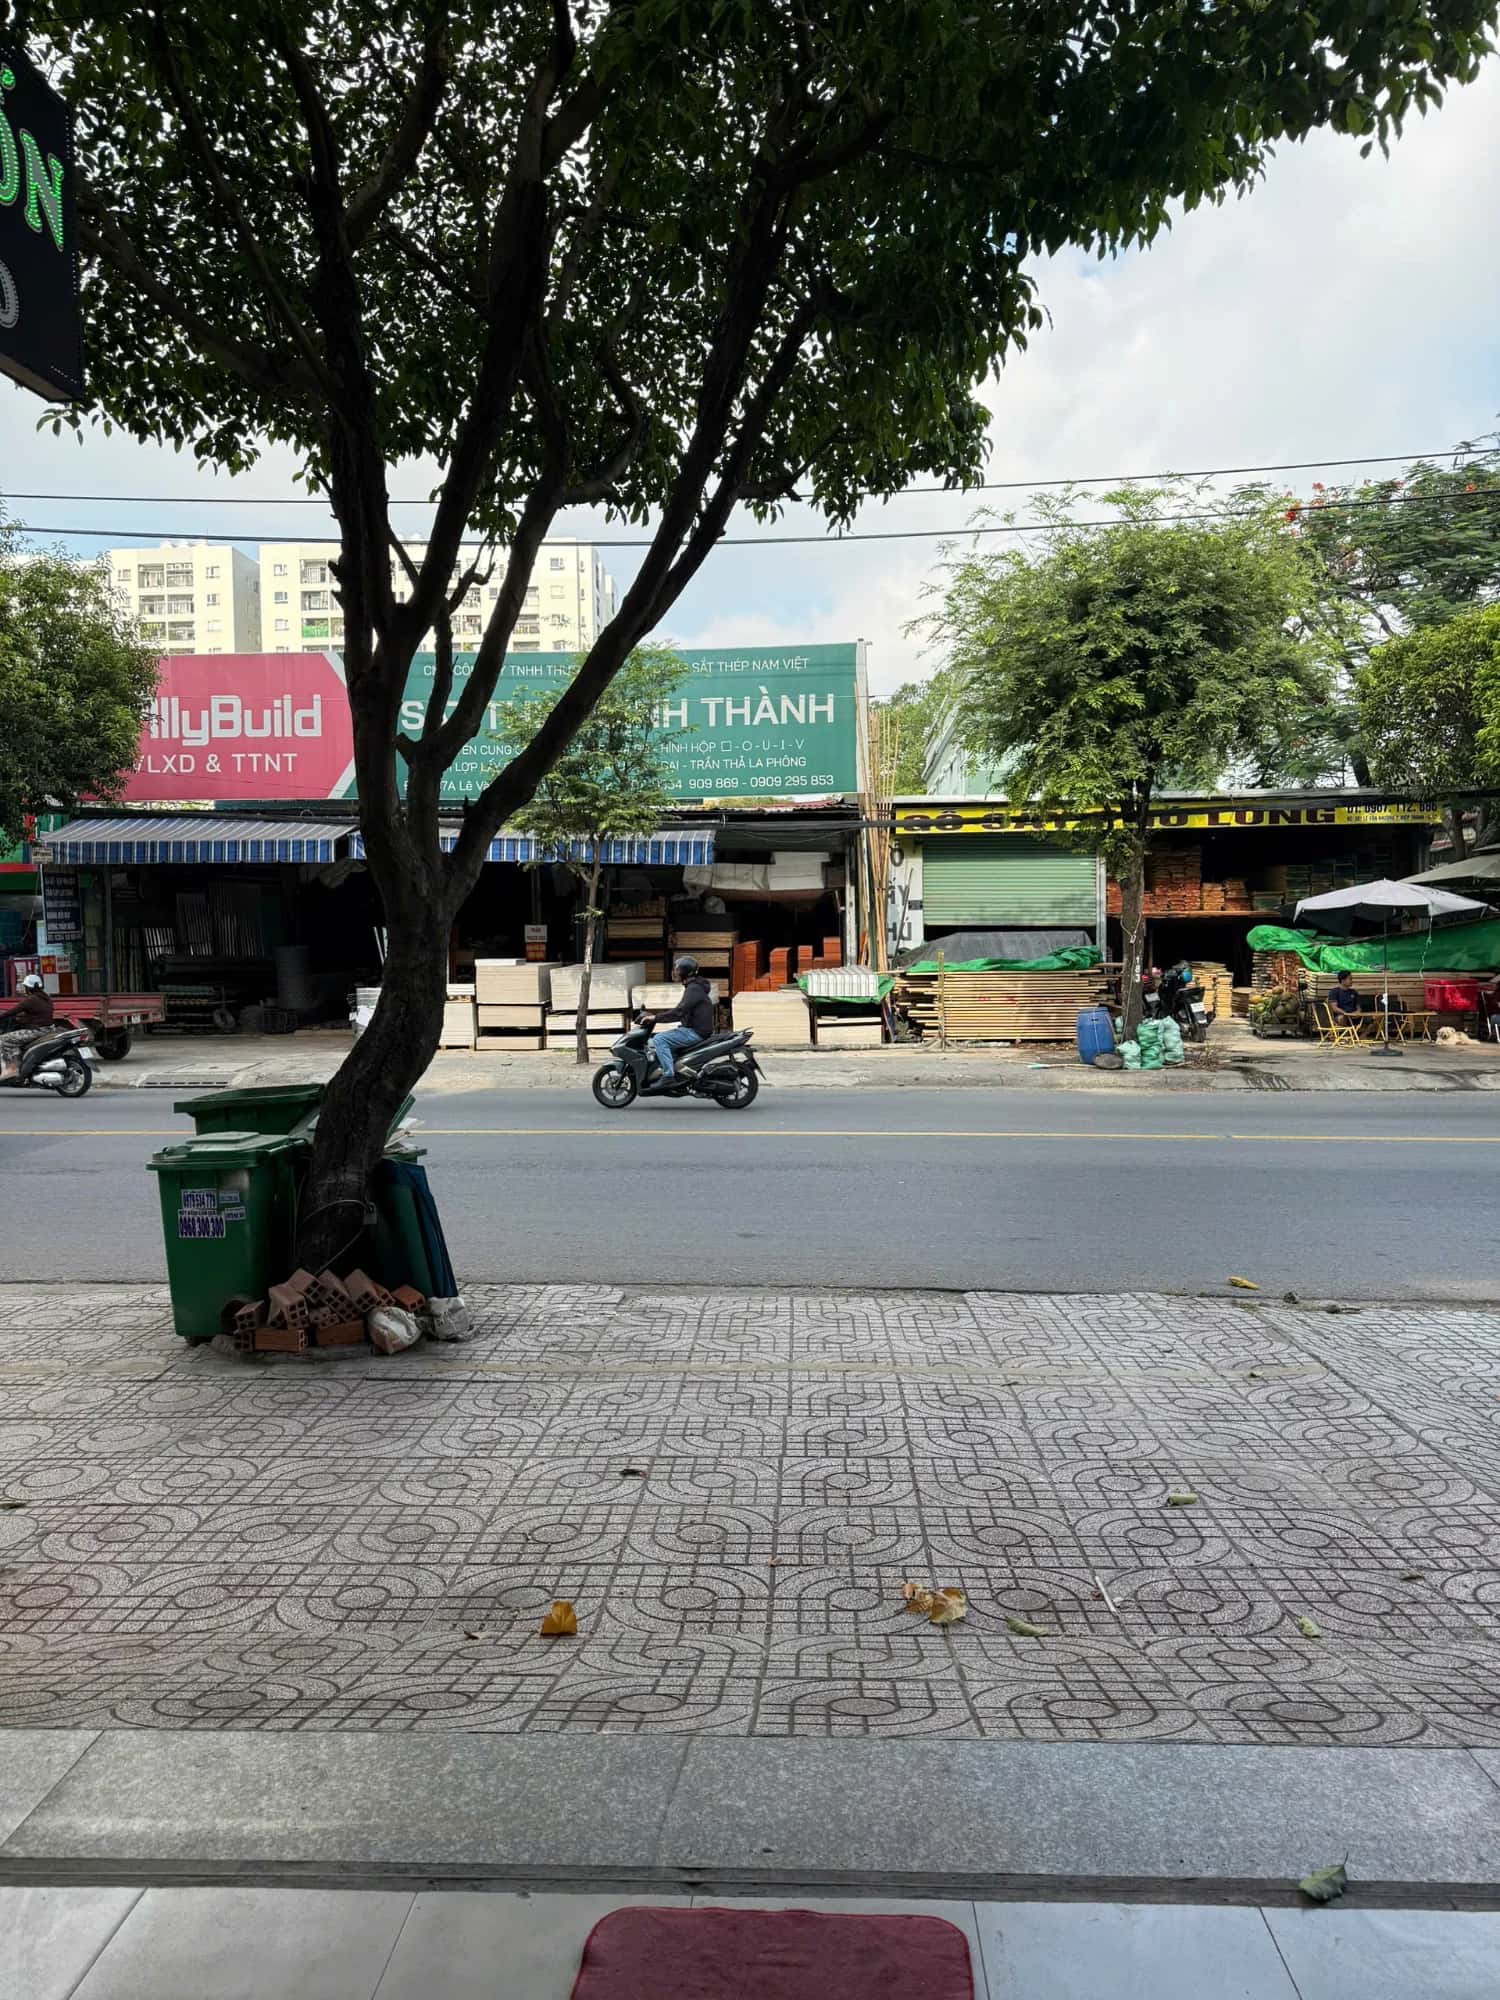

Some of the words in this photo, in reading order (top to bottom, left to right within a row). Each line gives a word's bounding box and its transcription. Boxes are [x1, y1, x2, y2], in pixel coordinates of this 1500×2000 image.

[510, 664, 543, 677] TNHH
[718, 658, 750, 673] THÉP
[752, 659, 780, 671] NAM
[782, 655, 810, 672] VIỆT
[700, 684, 835, 728] THÀNH
[480, 745, 512, 756] CUNG
[661, 740, 688, 754] HÌNH
[690, 740, 716, 755] HỘP
[231, 752, 298, 774] TTNT
[455, 761, 478, 774] LỢP
[723, 754, 746, 769] THẢ
[748, 758, 764, 768] LA
[766, 754, 807, 768] PHÔNG
[458, 780, 473, 791] Lê
[688, 778, 712, 789] 909
[715, 777, 739, 789] 869
[750, 775, 782, 788] 0909
[785, 775, 808, 787] 295
[810, 774, 834, 786] 853
[1206, 807, 1337, 828] LONG
